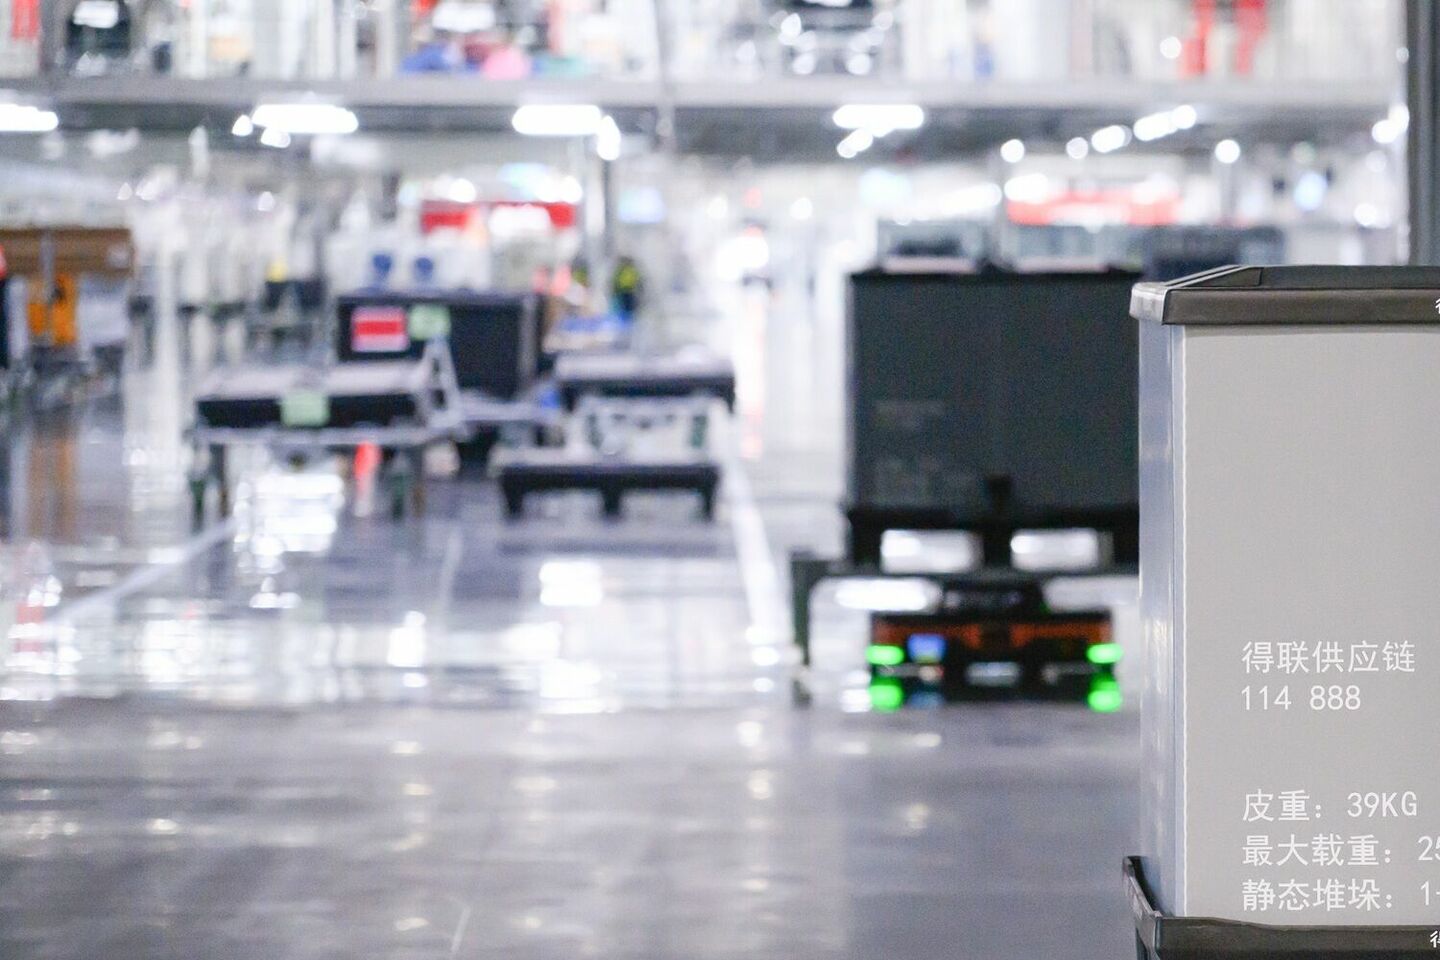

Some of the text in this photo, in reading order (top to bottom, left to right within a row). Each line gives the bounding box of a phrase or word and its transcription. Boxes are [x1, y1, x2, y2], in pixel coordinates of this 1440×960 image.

[1241, 640, 1416, 674] 得联供应链
[1241, 684, 1361, 711] 114 888
